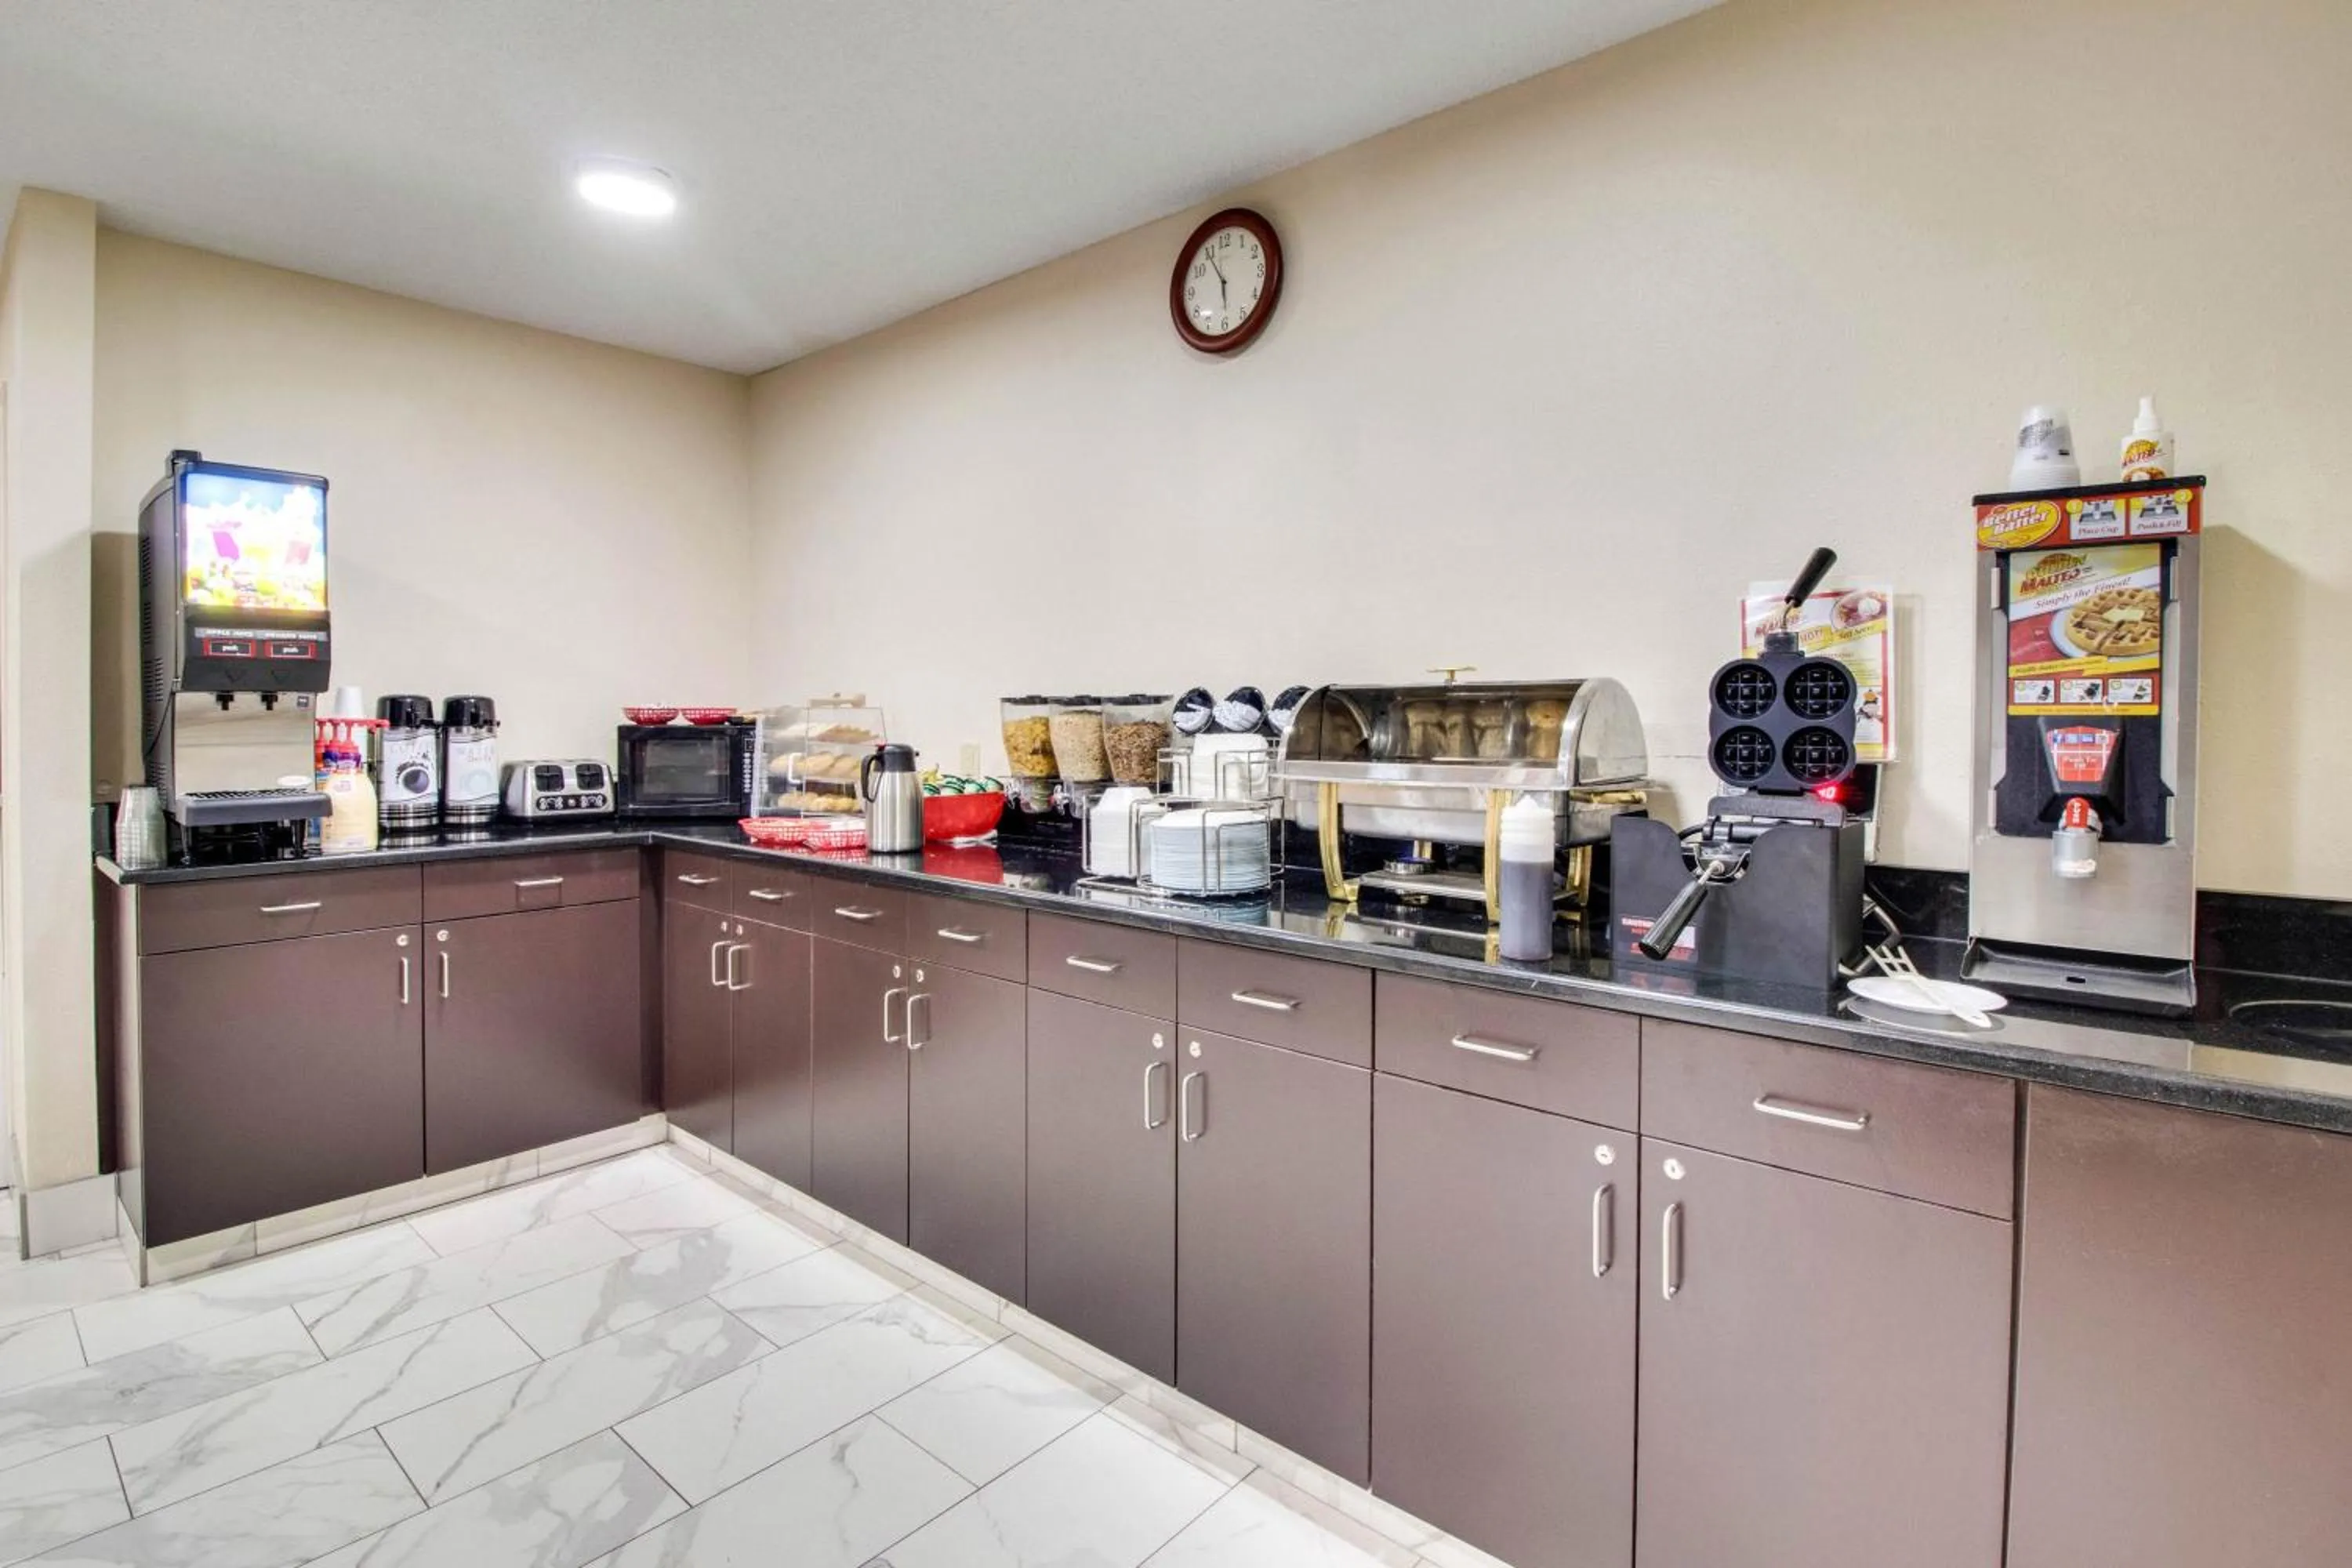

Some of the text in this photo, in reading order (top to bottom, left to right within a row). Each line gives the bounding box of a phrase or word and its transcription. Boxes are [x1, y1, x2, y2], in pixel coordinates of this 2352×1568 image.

[1218, 233, 1231, 249] 12
[1239, 234, 1245, 249] 1
[1250, 244, 1258, 260] 2
[1194, 263, 1206, 278] 10
[1257, 263, 1265, 278] 3
[1187, 286, 1195, 300] 9
[1252, 286, 1258, 299] 4
[1193, 304, 1200, 318] 8
[1240, 305, 1247, 320] 5
[1221, 316, 1228, 330] 6
